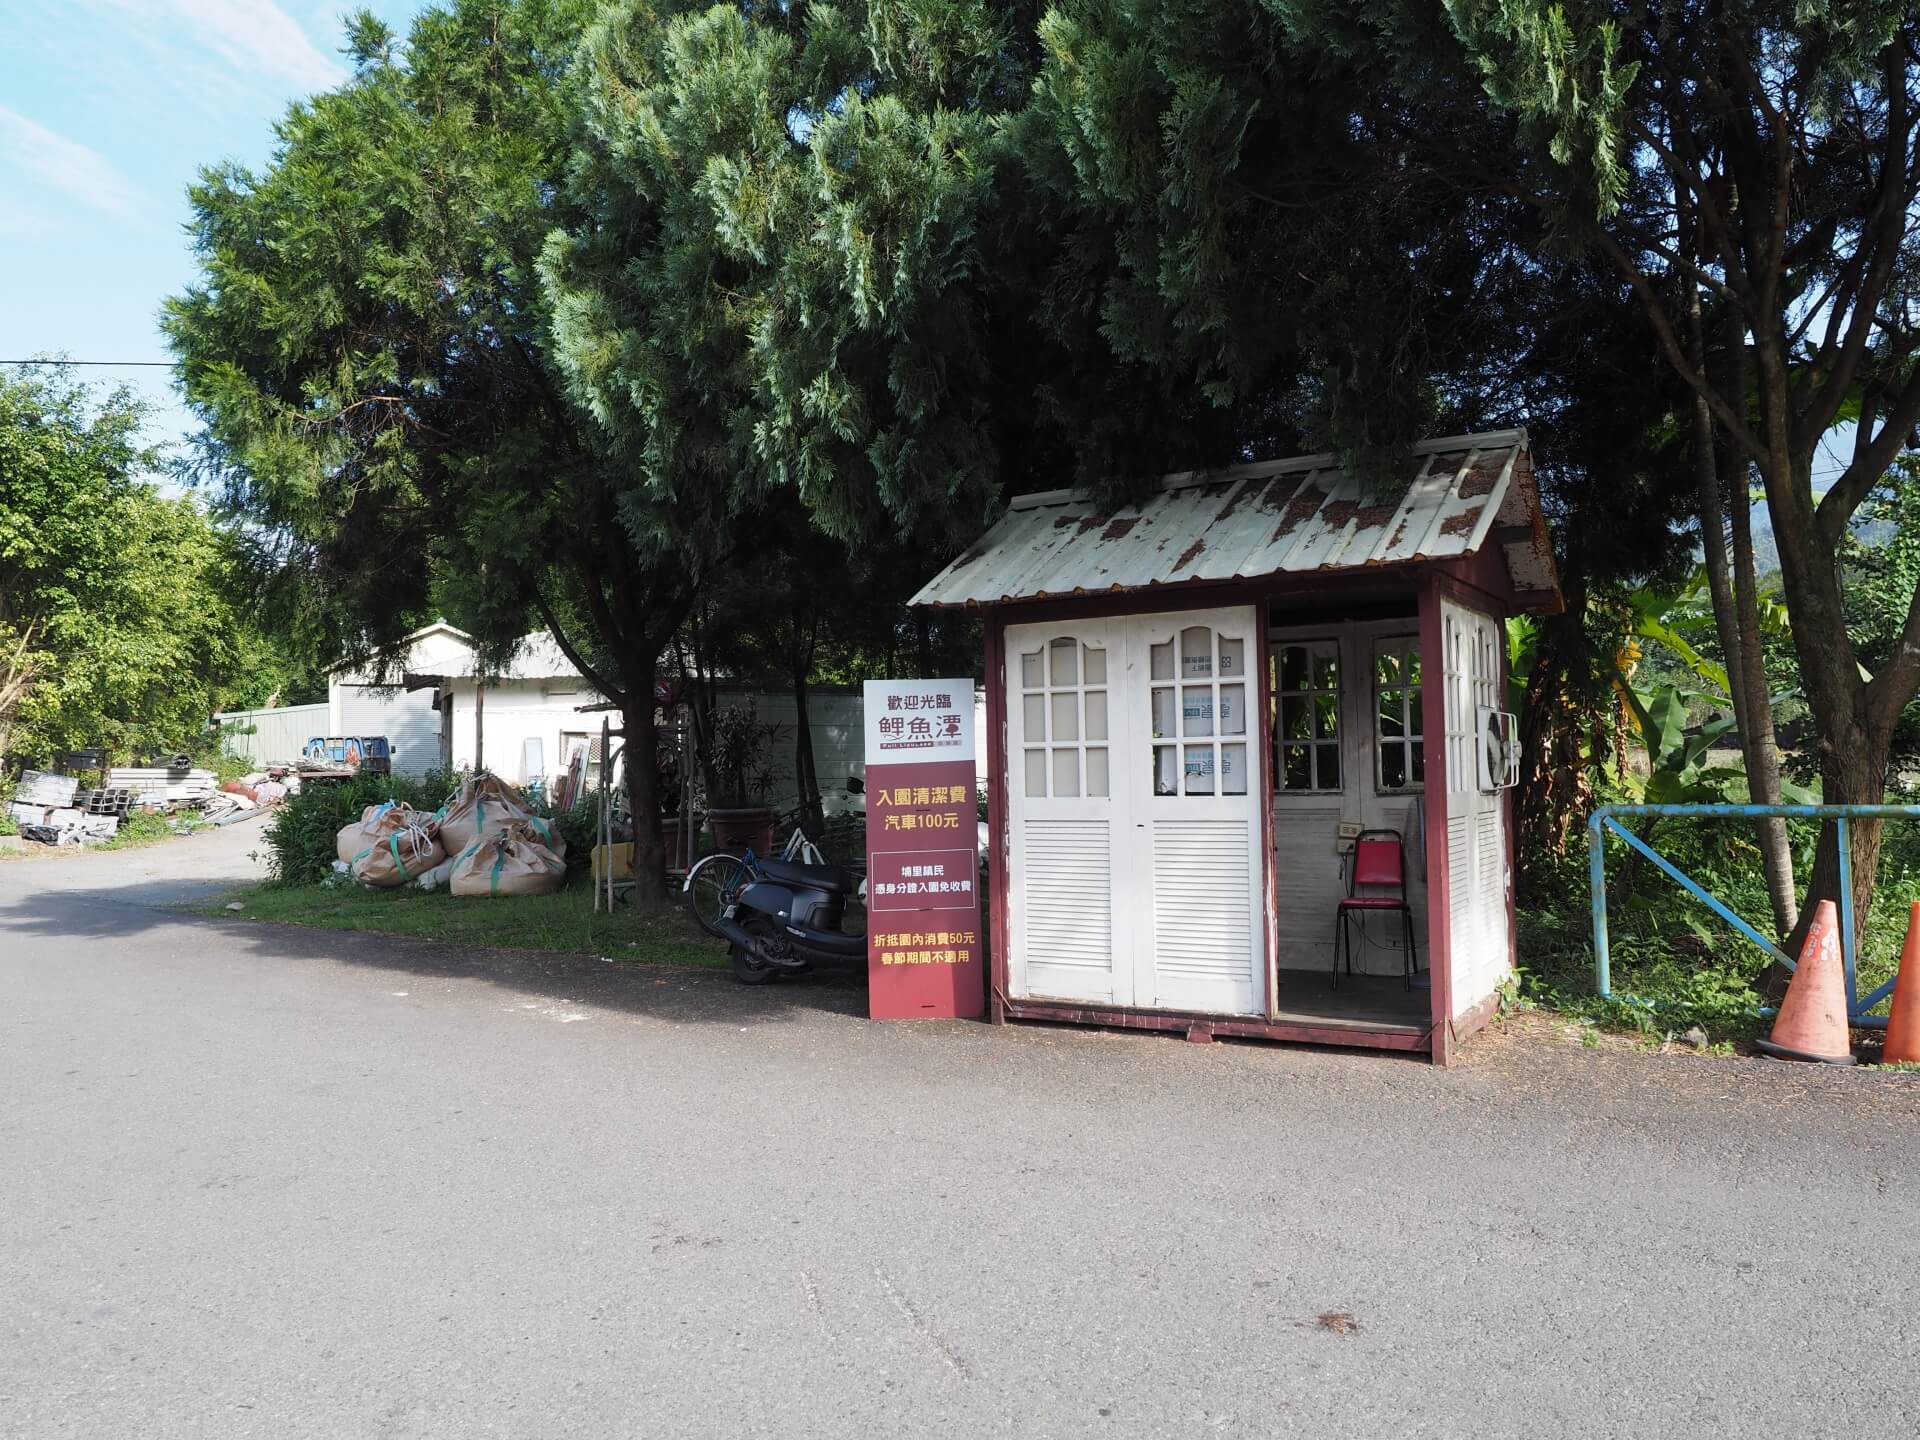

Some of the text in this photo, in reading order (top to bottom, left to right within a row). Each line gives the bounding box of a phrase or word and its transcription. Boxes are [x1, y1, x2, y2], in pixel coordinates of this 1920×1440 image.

[888, 694, 951, 710] 歡迎光臨
[879, 715, 961, 740] 鯉魚潭
[876, 785, 966, 806] 入園清潔費
[885, 812, 958, 830] 汽車100元
